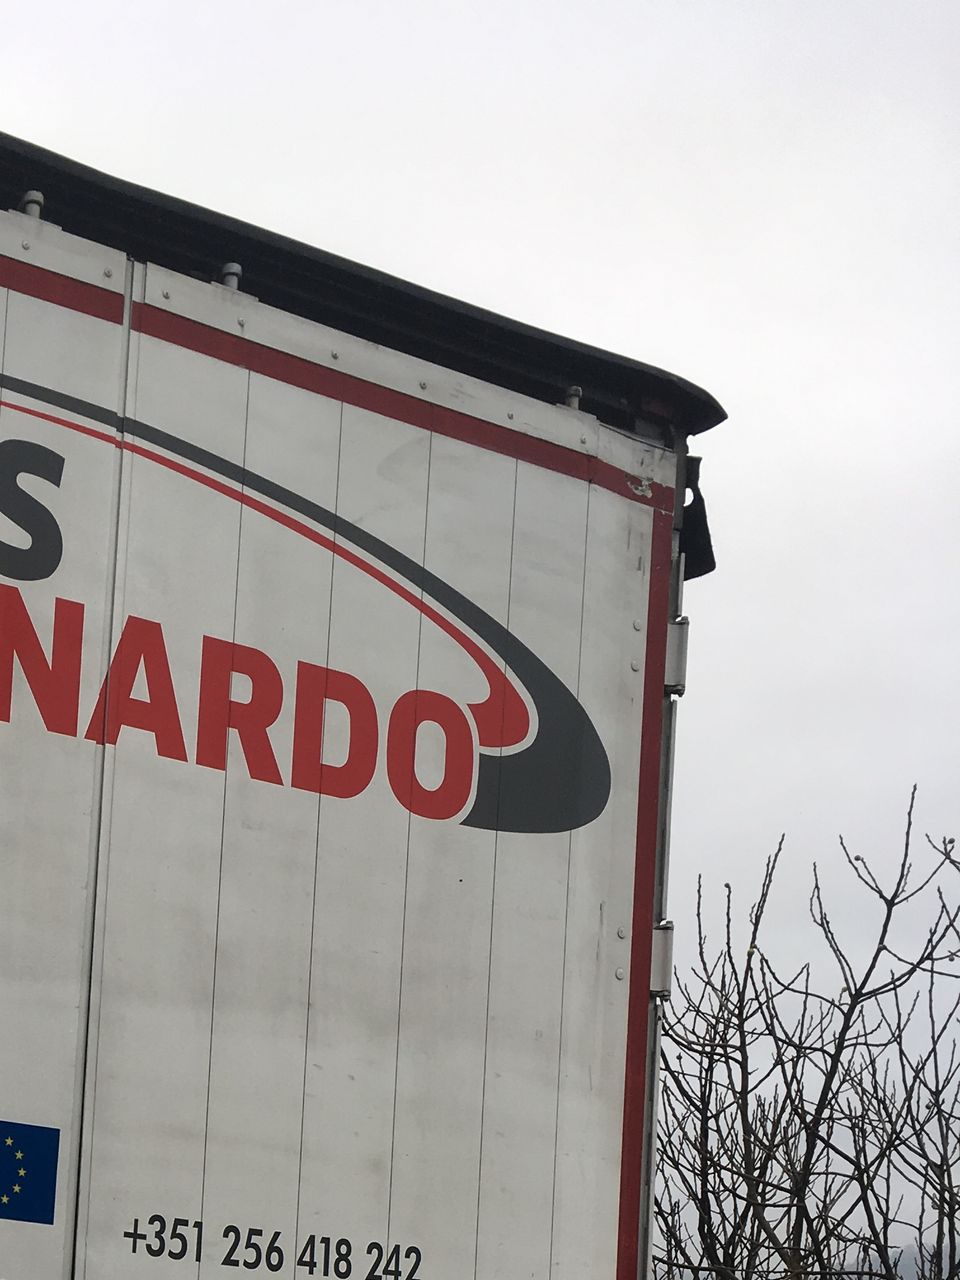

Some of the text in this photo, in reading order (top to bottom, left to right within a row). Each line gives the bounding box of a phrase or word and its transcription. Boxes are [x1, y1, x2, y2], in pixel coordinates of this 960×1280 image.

[123, 1214, 204, 1263] +351
[221, 1224, 285, 1273] 256
[296, 1234, 353, 1280] 418
